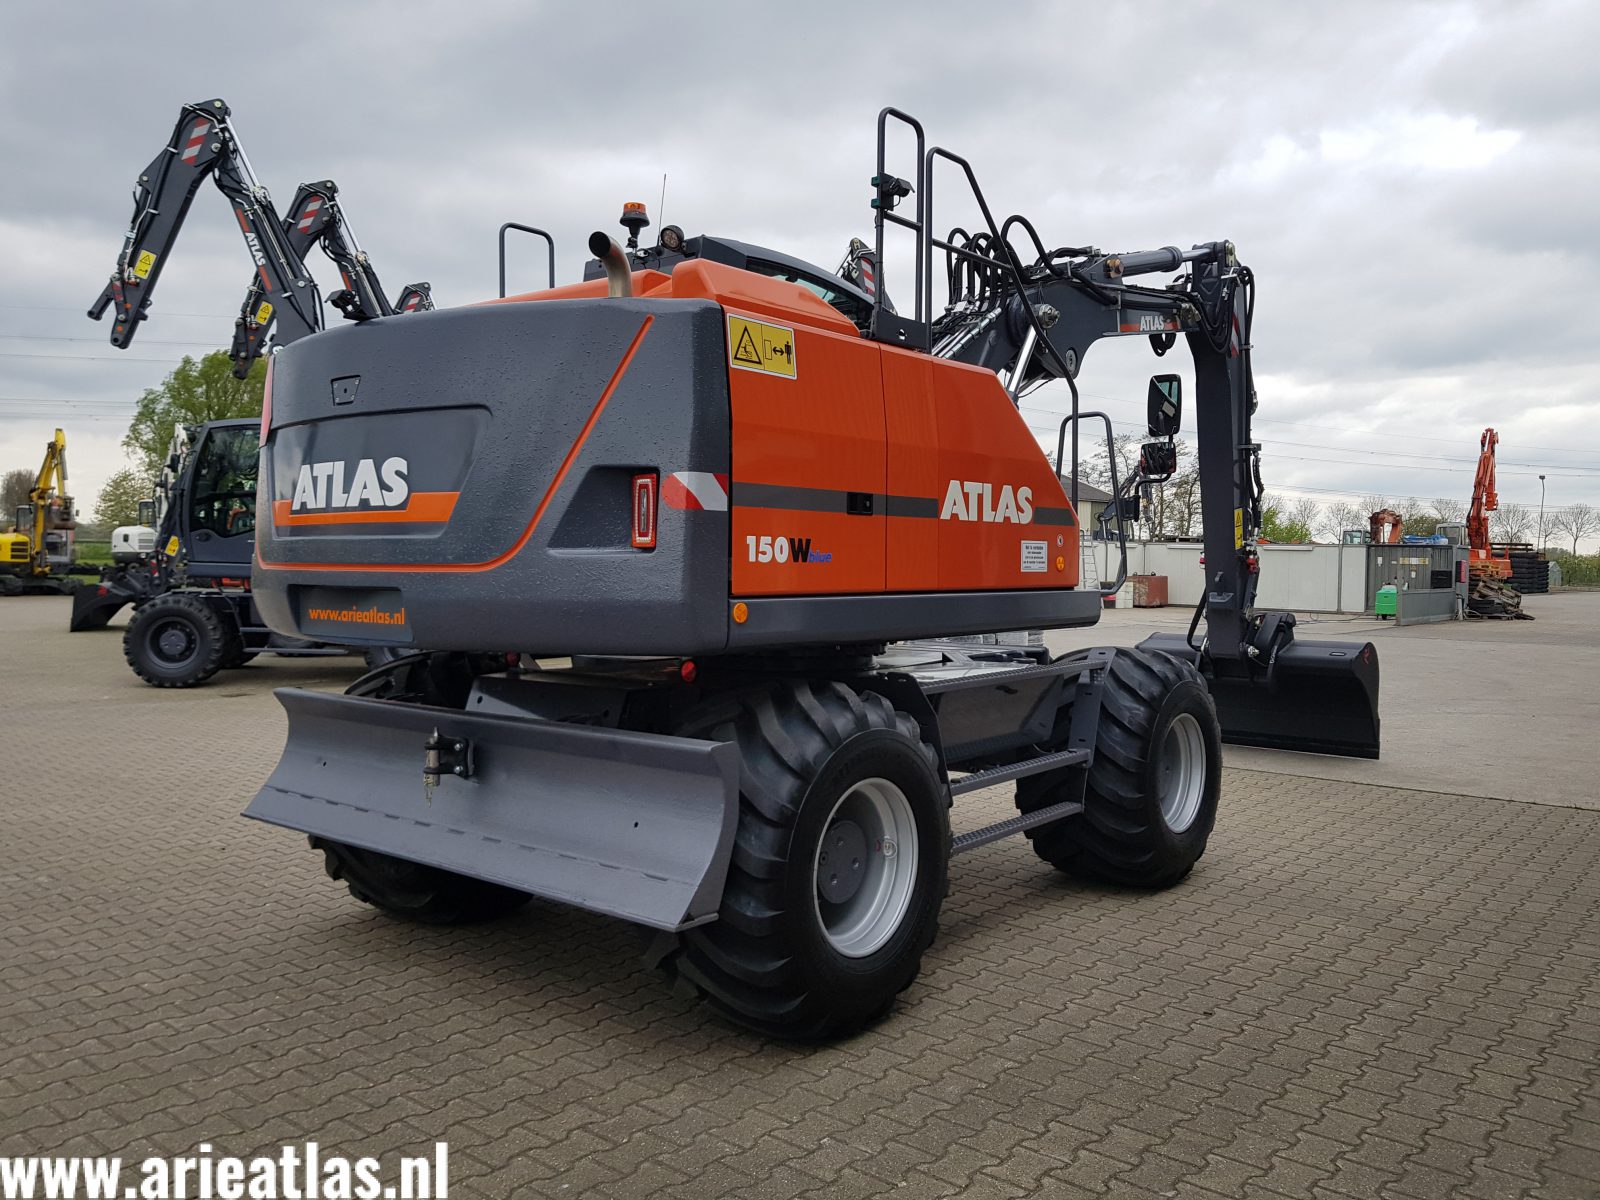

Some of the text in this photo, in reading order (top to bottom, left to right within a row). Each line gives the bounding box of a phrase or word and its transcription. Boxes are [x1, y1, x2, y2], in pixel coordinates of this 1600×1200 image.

[245, 232, 266, 266] ATLAS
[1140, 315, 1165, 331] ATLAS
[291, 457, 409, 511] ATLAS
[940, 479, 1033, 525] ATLAS
[308, 605, 405, 625] www.arieatlas.nl
